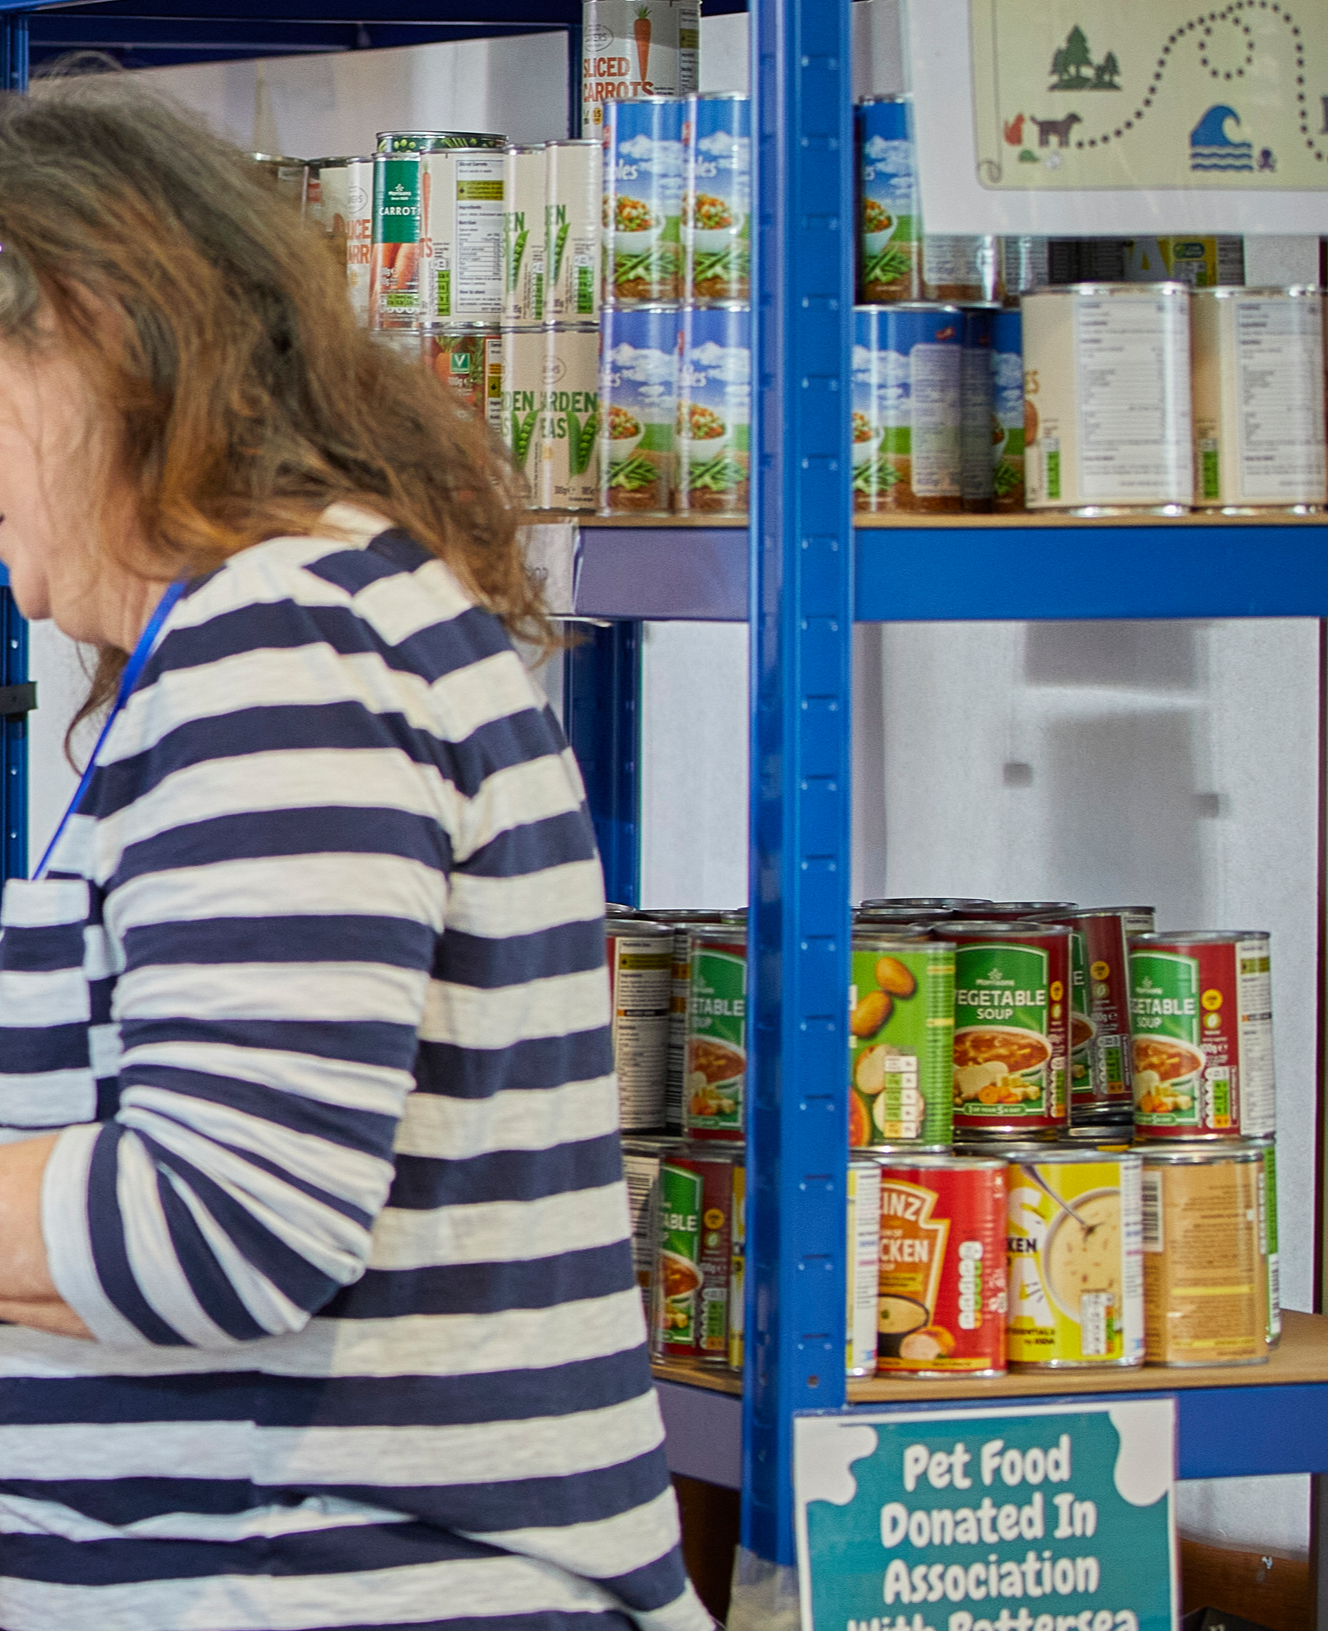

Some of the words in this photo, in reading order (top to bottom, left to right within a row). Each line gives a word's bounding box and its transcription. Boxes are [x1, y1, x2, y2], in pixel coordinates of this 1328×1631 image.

[583, 57, 631, 78] SLICED
[582, 82, 655, 102] CARROTS
[346, 219, 372, 240] LICE
[502, 391, 535, 413] DEN
[541, 391, 599, 413] RDEN
[542, 418, 567, 438] EAS
[692, 998, 745, 1015] ETABLE
[954, 989, 1046, 1006] EGETABLE
[1131, 998, 1195, 1014] ETABLE
[976, 1007, 1014, 1020] SOUP
[883, 1192, 922, 1221] INZ
[880, 1239, 929, 1263] CKEN
[903, 1442, 973, 1492] Pet
[980, 1433, 1072, 1486] Food
[880, 1491, 1045, 1548] Donated
[1053, 1492, 1098, 1539] In
[883, 1550, 1100, 1605] Association
[948, 1607, 1140, 1631] ttersea
